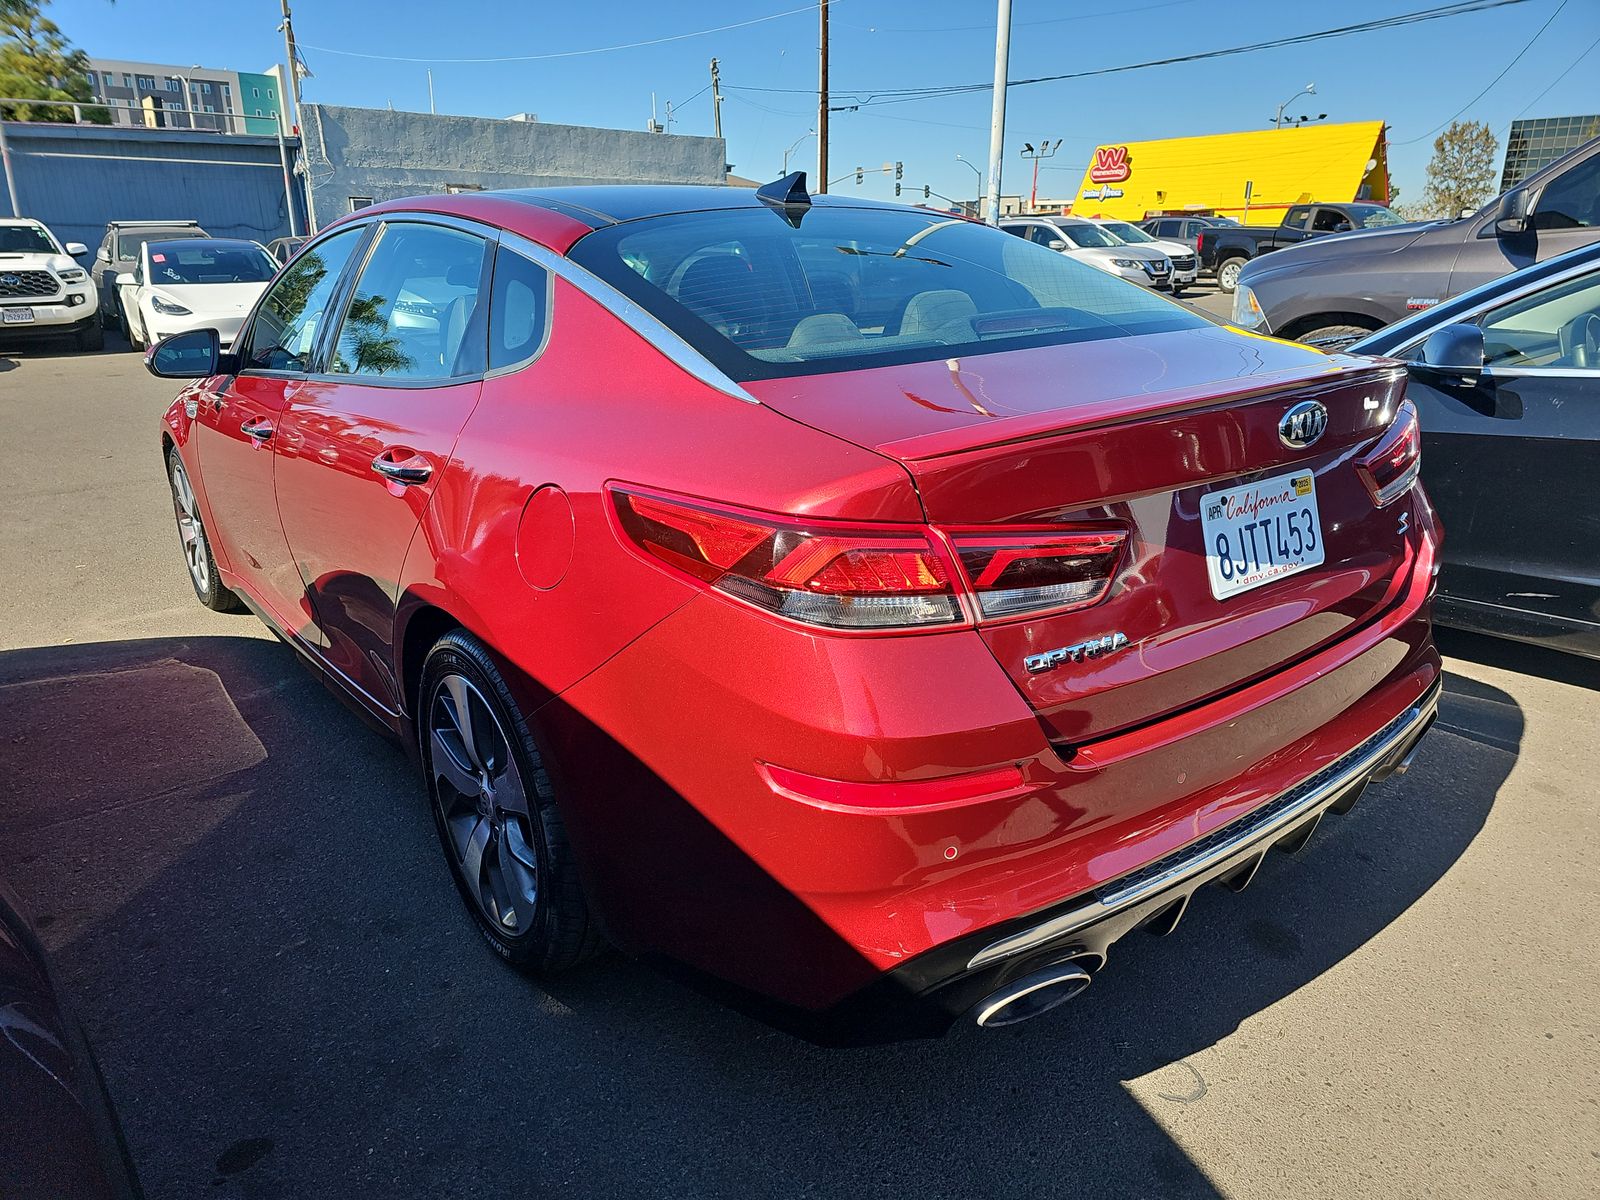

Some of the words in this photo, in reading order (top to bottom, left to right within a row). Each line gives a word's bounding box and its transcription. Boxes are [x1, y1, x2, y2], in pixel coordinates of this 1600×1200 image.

[1291, 410, 1323, 440] KIA
[1208, 504, 1223, 520] APR
[1225, 487, 1297, 520] California
[1396, 511, 1409, 535] S
[1216, 508, 1316, 580] 8JTT453
[1243, 561, 1299, 585] dmv.ca.gov
[1024, 632, 1129, 672] OPTIMA
